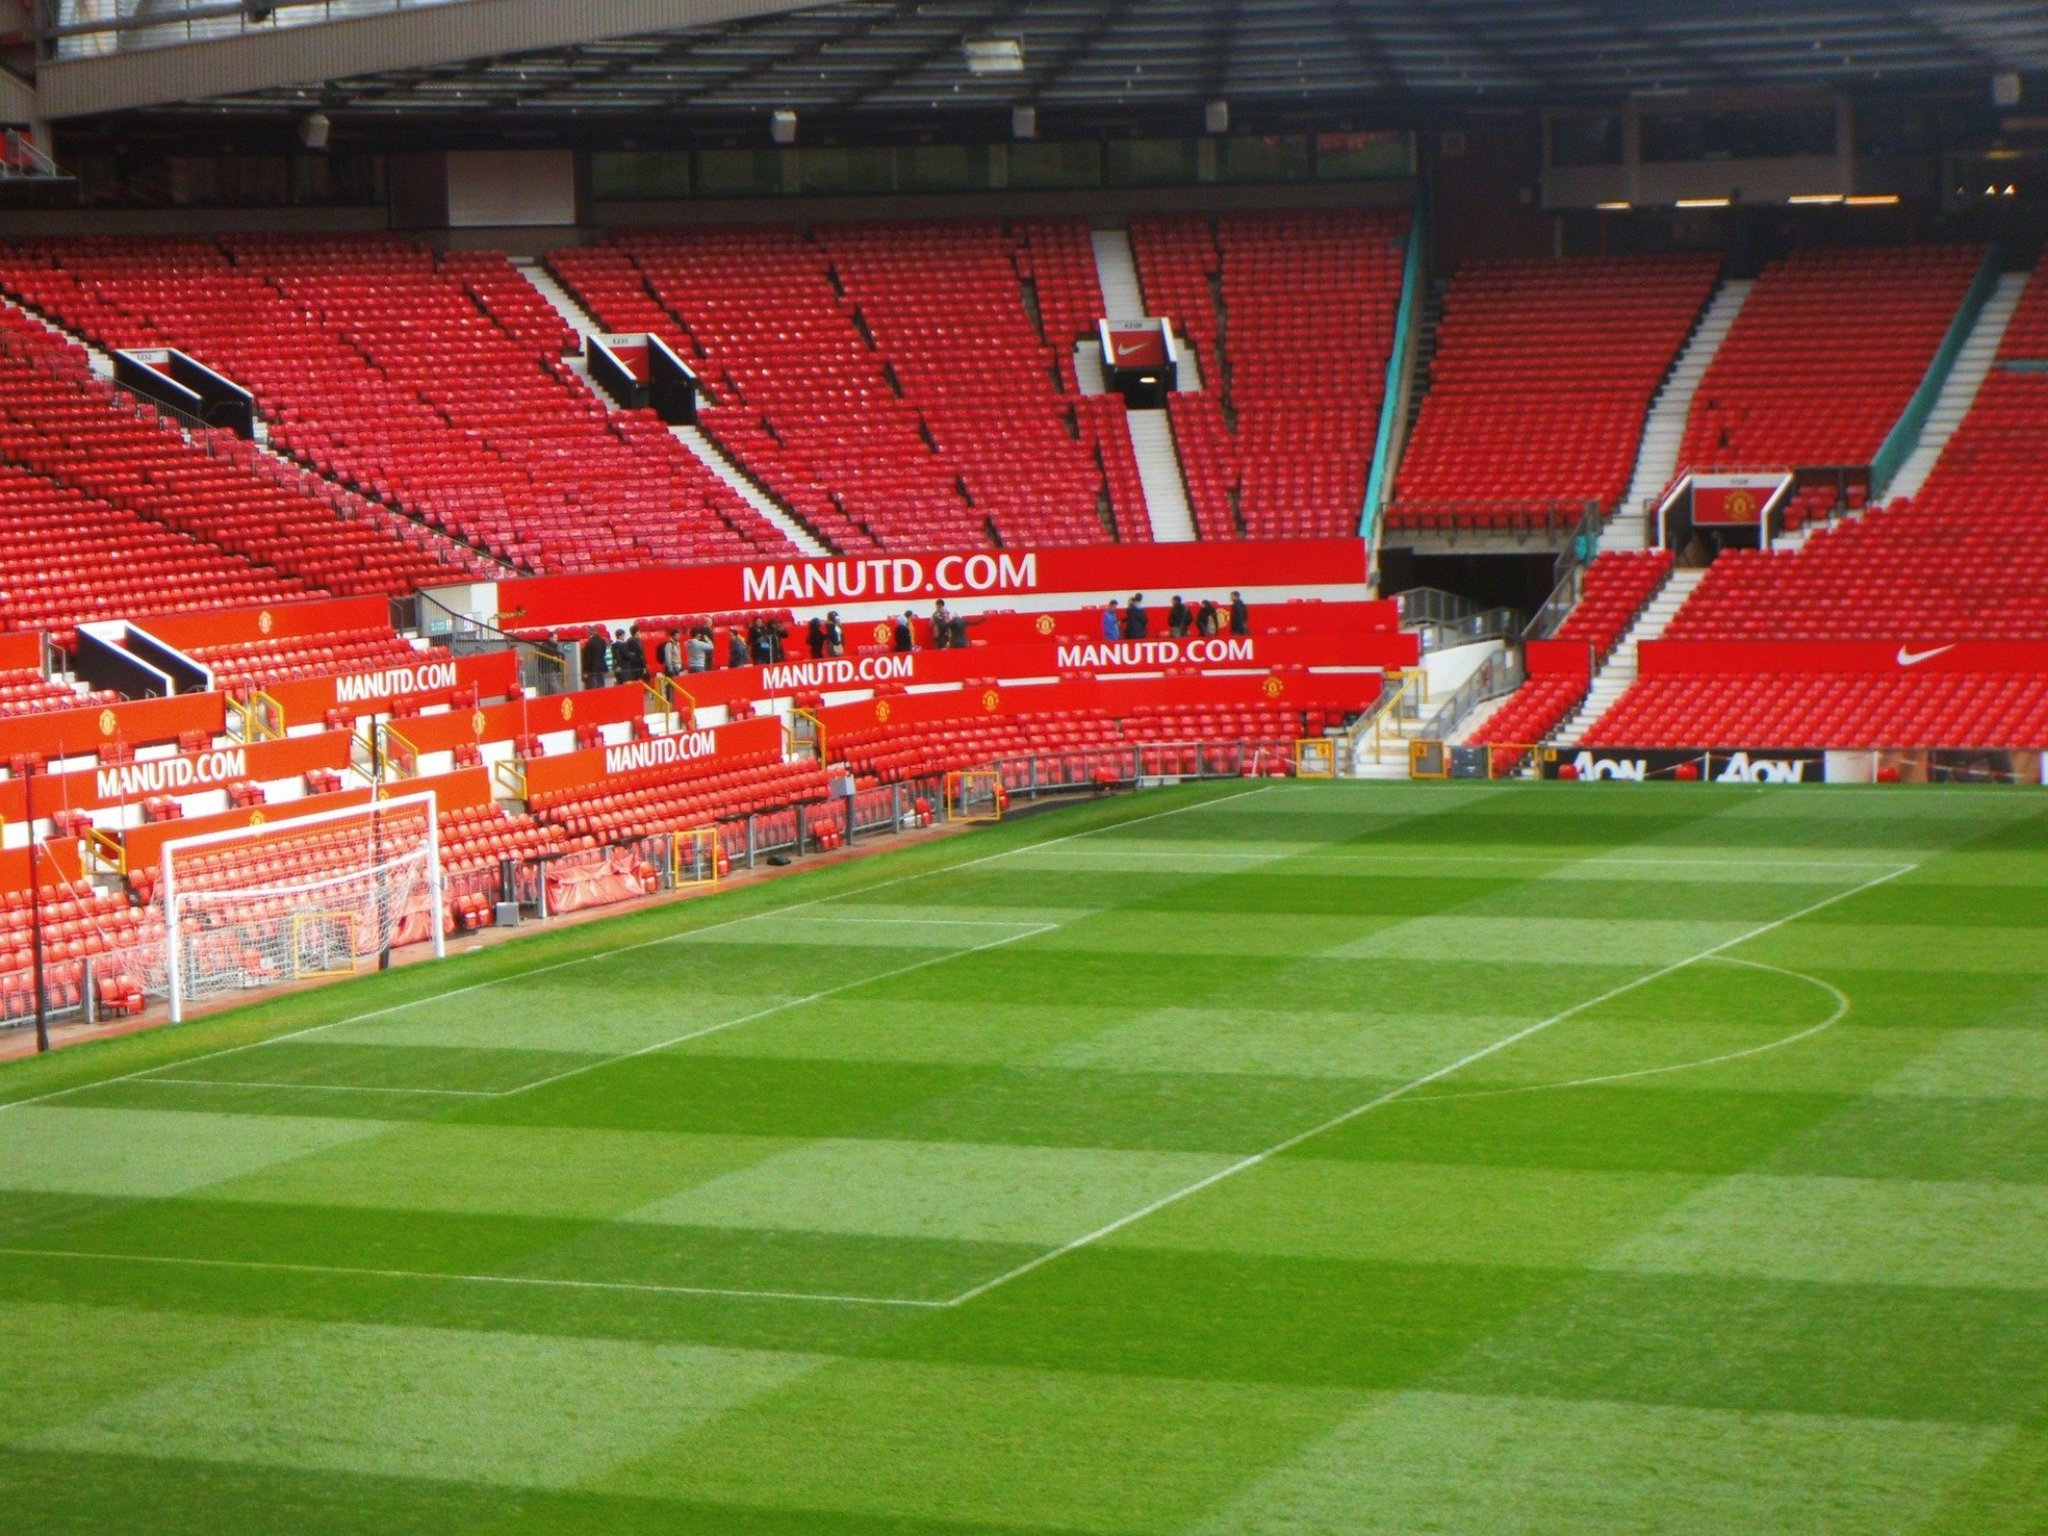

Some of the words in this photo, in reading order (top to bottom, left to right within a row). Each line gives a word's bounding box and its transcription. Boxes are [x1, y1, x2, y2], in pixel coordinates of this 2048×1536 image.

[743, 553, 1037, 602] MANUTD.COM
[763, 655, 914, 690] MANUTD.COM
[1057, 639, 1254, 668] MANUTD.COM
[336, 661, 457, 702] MANUTD.COM
[606, 729, 716, 774] MANUTD.COM
[96, 748, 246, 799] MANUTD.COM
